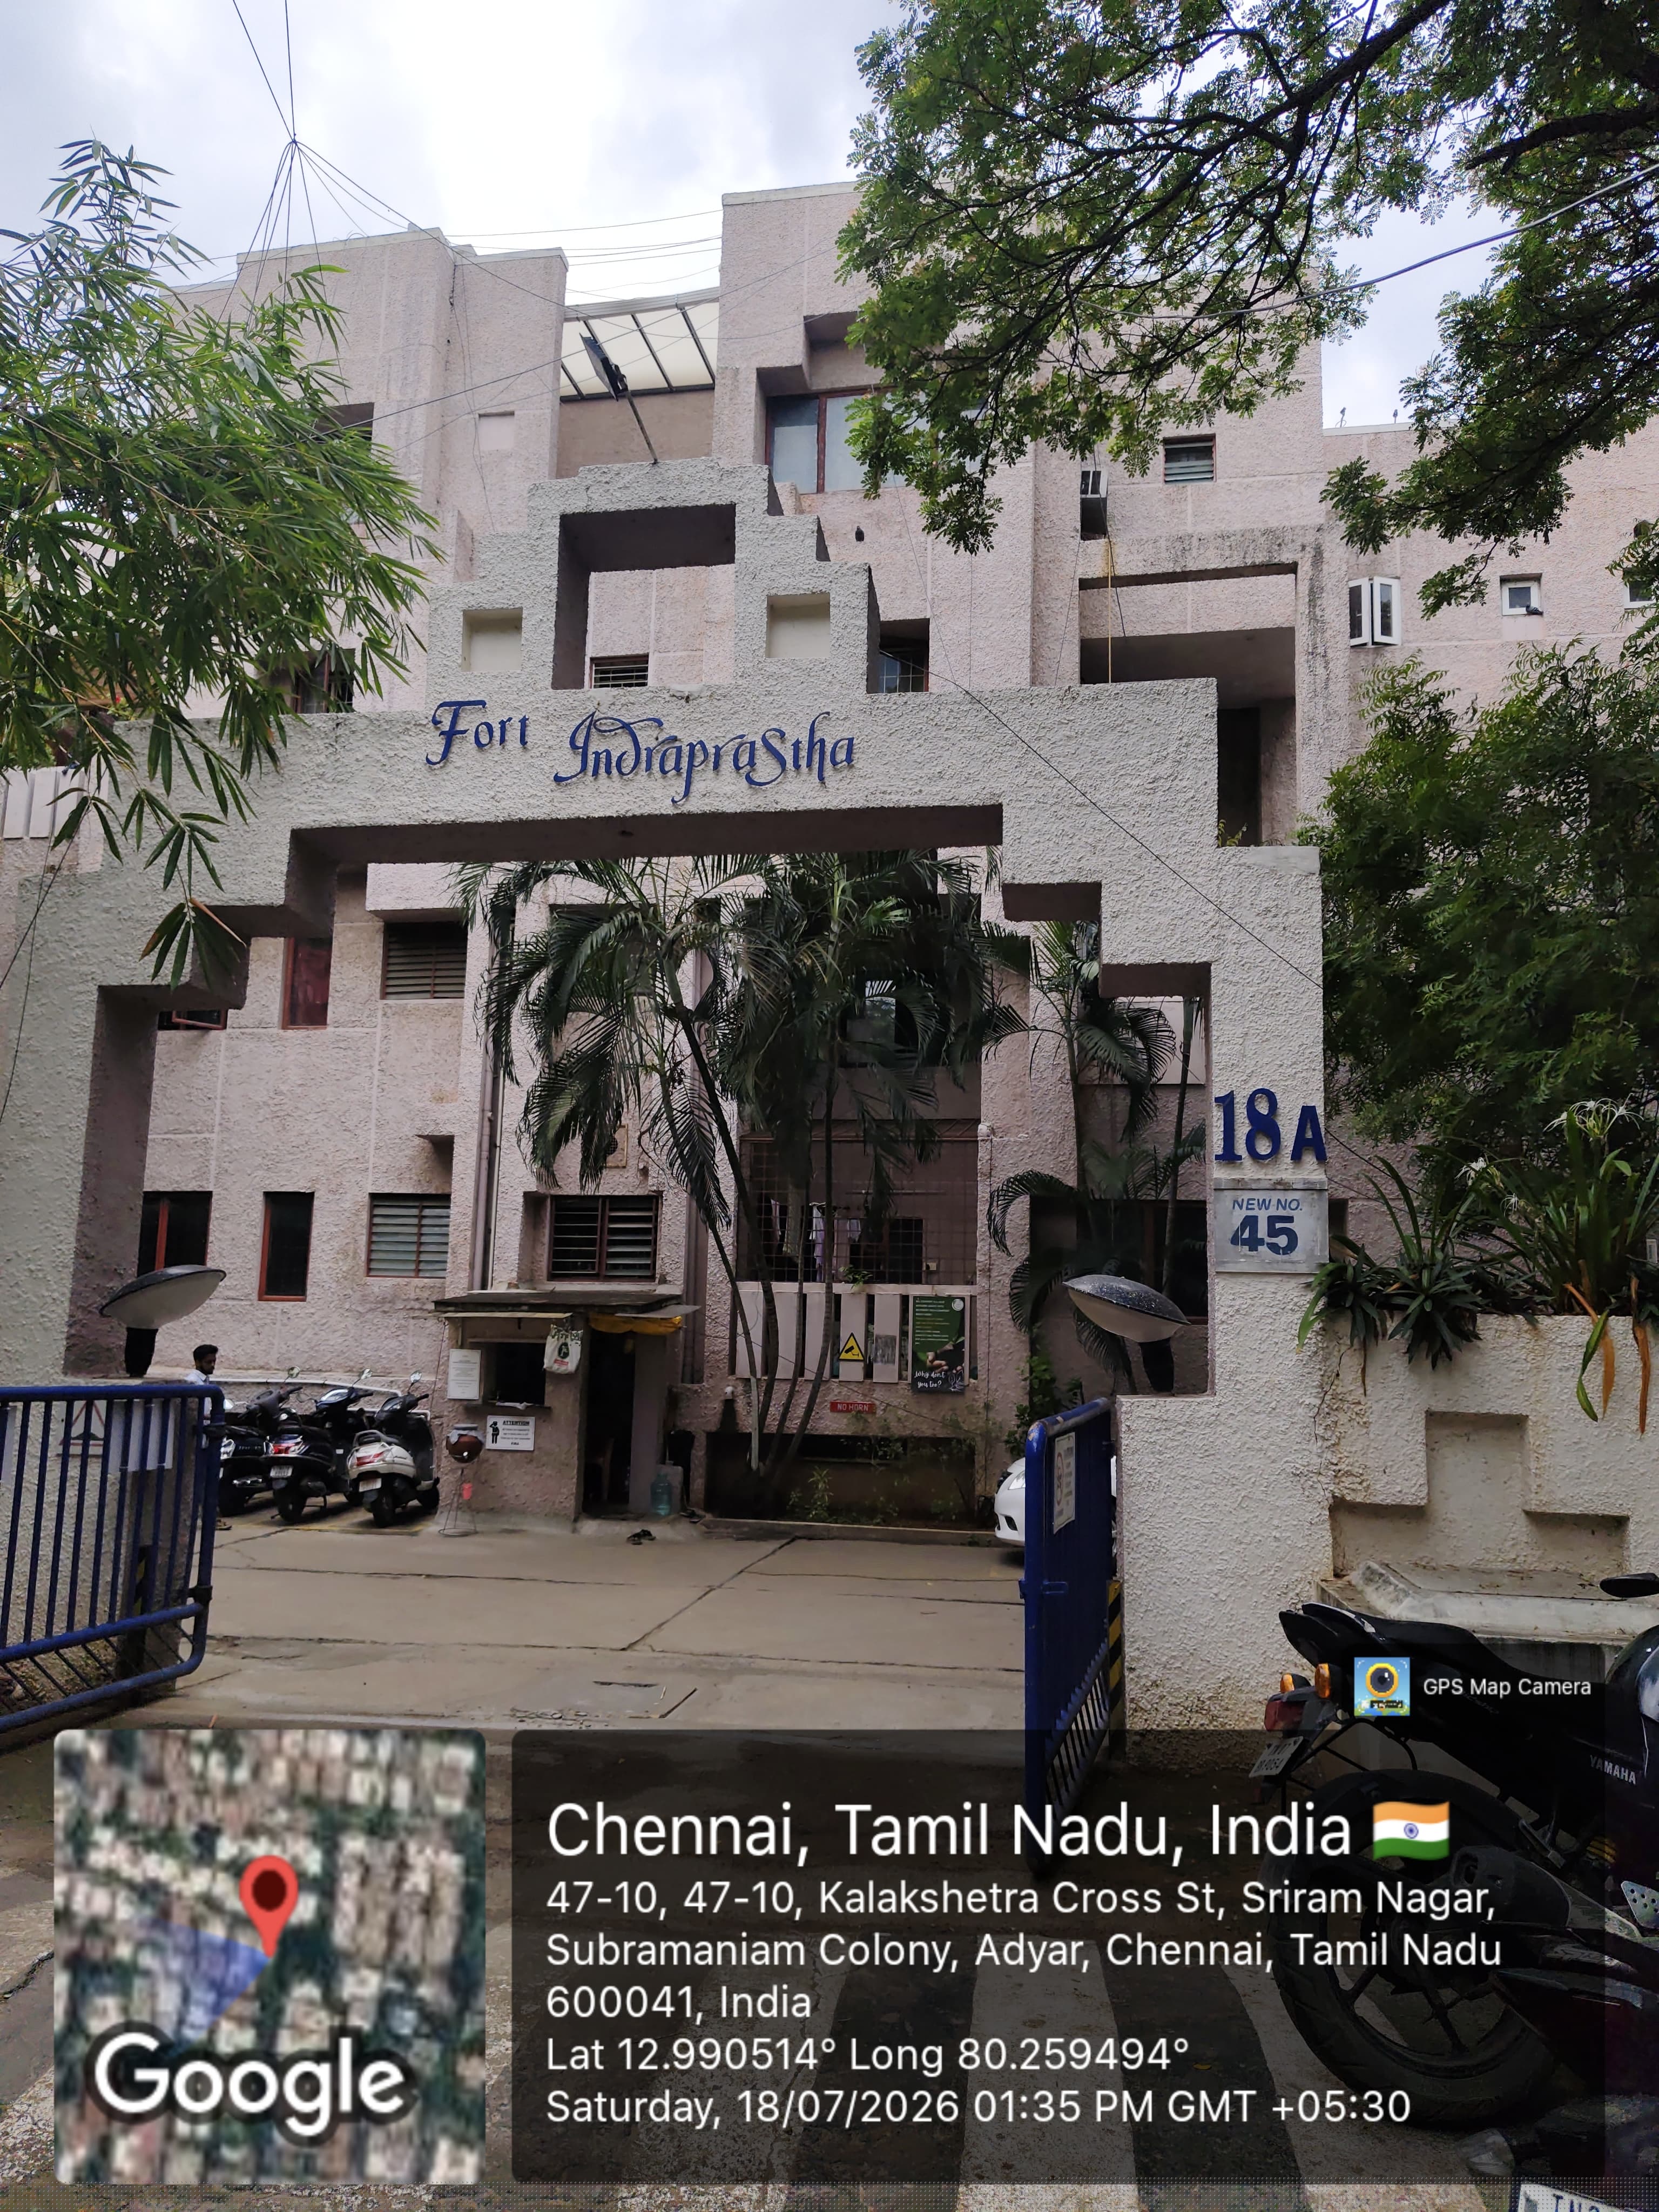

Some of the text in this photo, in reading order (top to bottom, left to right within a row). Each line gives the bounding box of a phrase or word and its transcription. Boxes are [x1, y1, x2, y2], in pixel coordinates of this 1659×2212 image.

[426, 699, 529, 766] Fort
[1232, 1197, 1303, 1212] NEW NO.
[1230, 1214, 1299, 1256] 45
[914, 1370, 929, 1379] Why
[848, 1404, 869, 1412] HORN
[1589, 1754, 1637, 1785] YAMAHA
